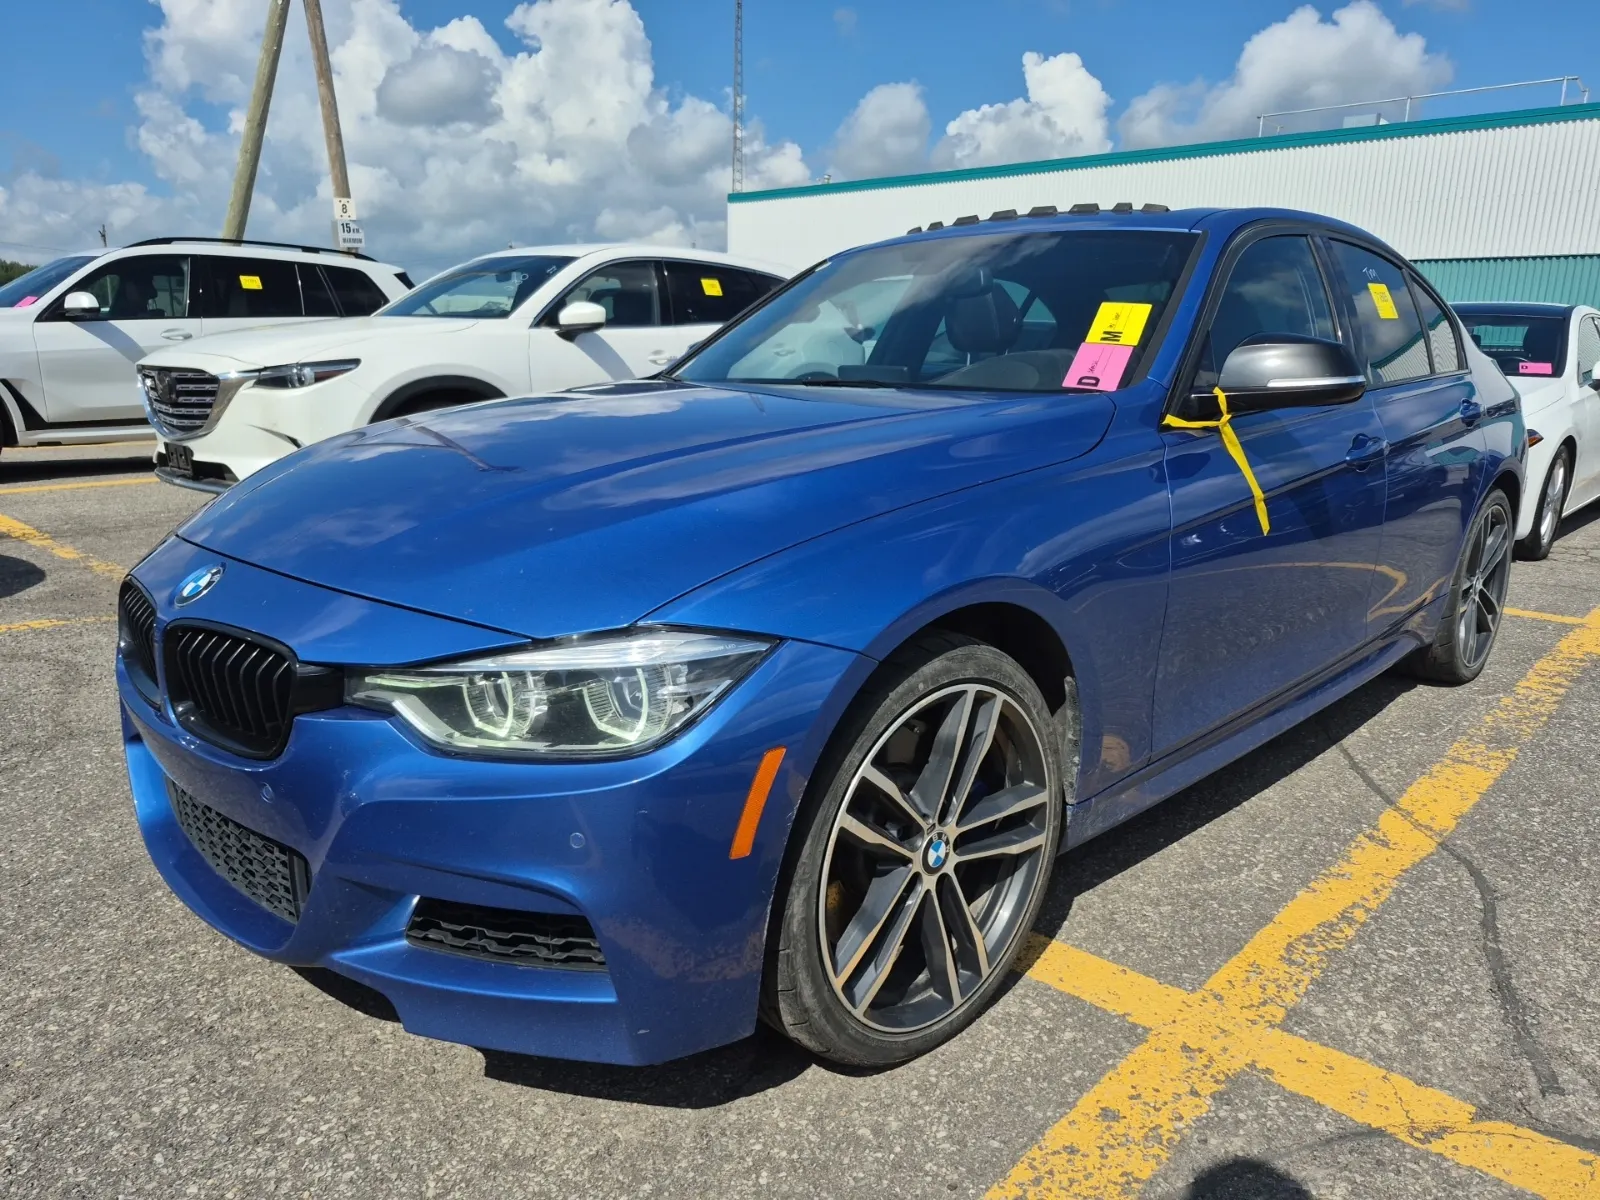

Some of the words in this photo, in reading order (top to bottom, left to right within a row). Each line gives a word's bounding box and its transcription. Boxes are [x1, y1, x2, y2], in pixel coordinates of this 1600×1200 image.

[341, 203, 348, 214] 8
[341, 222, 352, 234] 15
[1100, 330, 1123, 342] M
[1076, 375, 1100, 387] D
[932, 833, 951, 853] BMW
